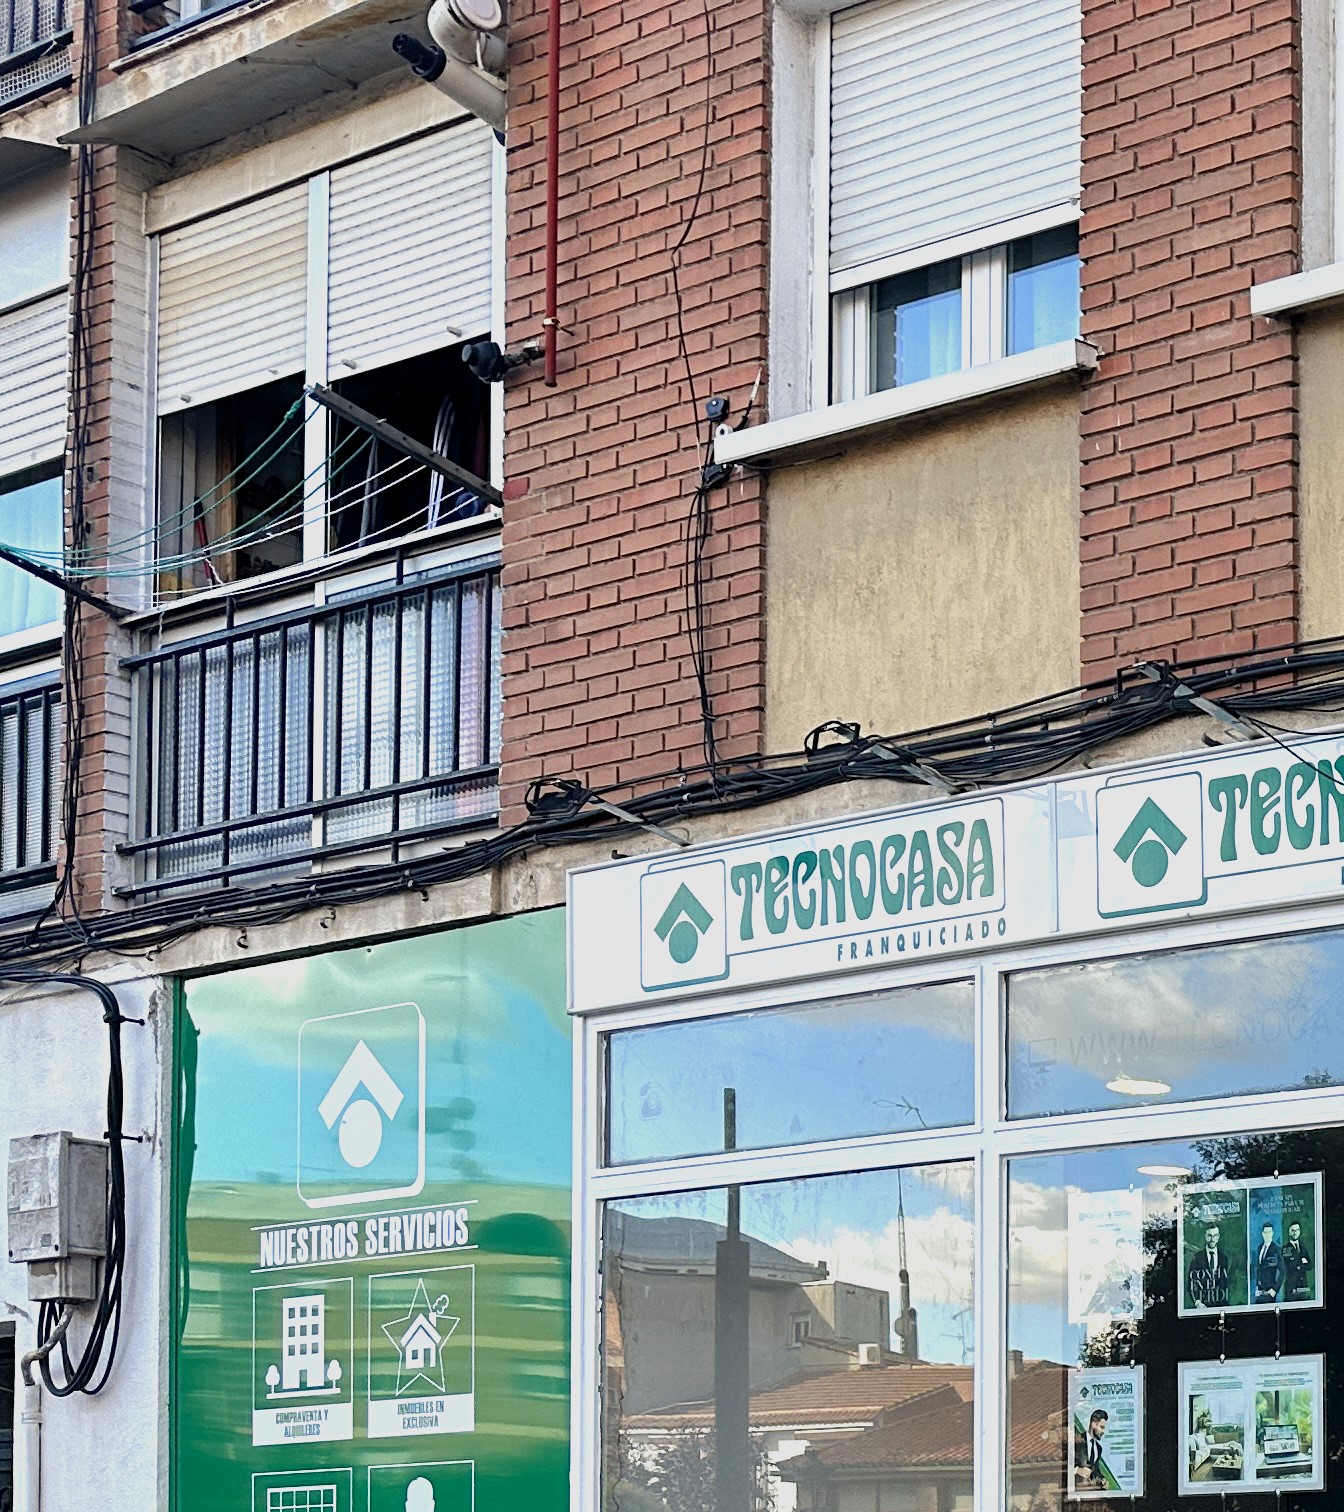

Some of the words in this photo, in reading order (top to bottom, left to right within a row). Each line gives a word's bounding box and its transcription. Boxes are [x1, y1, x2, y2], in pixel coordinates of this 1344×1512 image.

[731, 818, 995, 941] TECNOCASA
[837, 917, 1007, 963] FRANQUICIADO
[260, 1221, 359, 1268] NUESTROS
[365, 1207, 469, 1256] SERVICIOS
[397, 1401, 434, 1415] INMUEBLES
[435, 1400, 445, 1413] EN
[276, 1410, 322, 1424] COMPRAVENTA
[323, 1409, 329, 1421] Y
[402, 1415, 439, 1429] EXCLUSIVA
[284, 1424, 320, 1438] ALQUILERES
